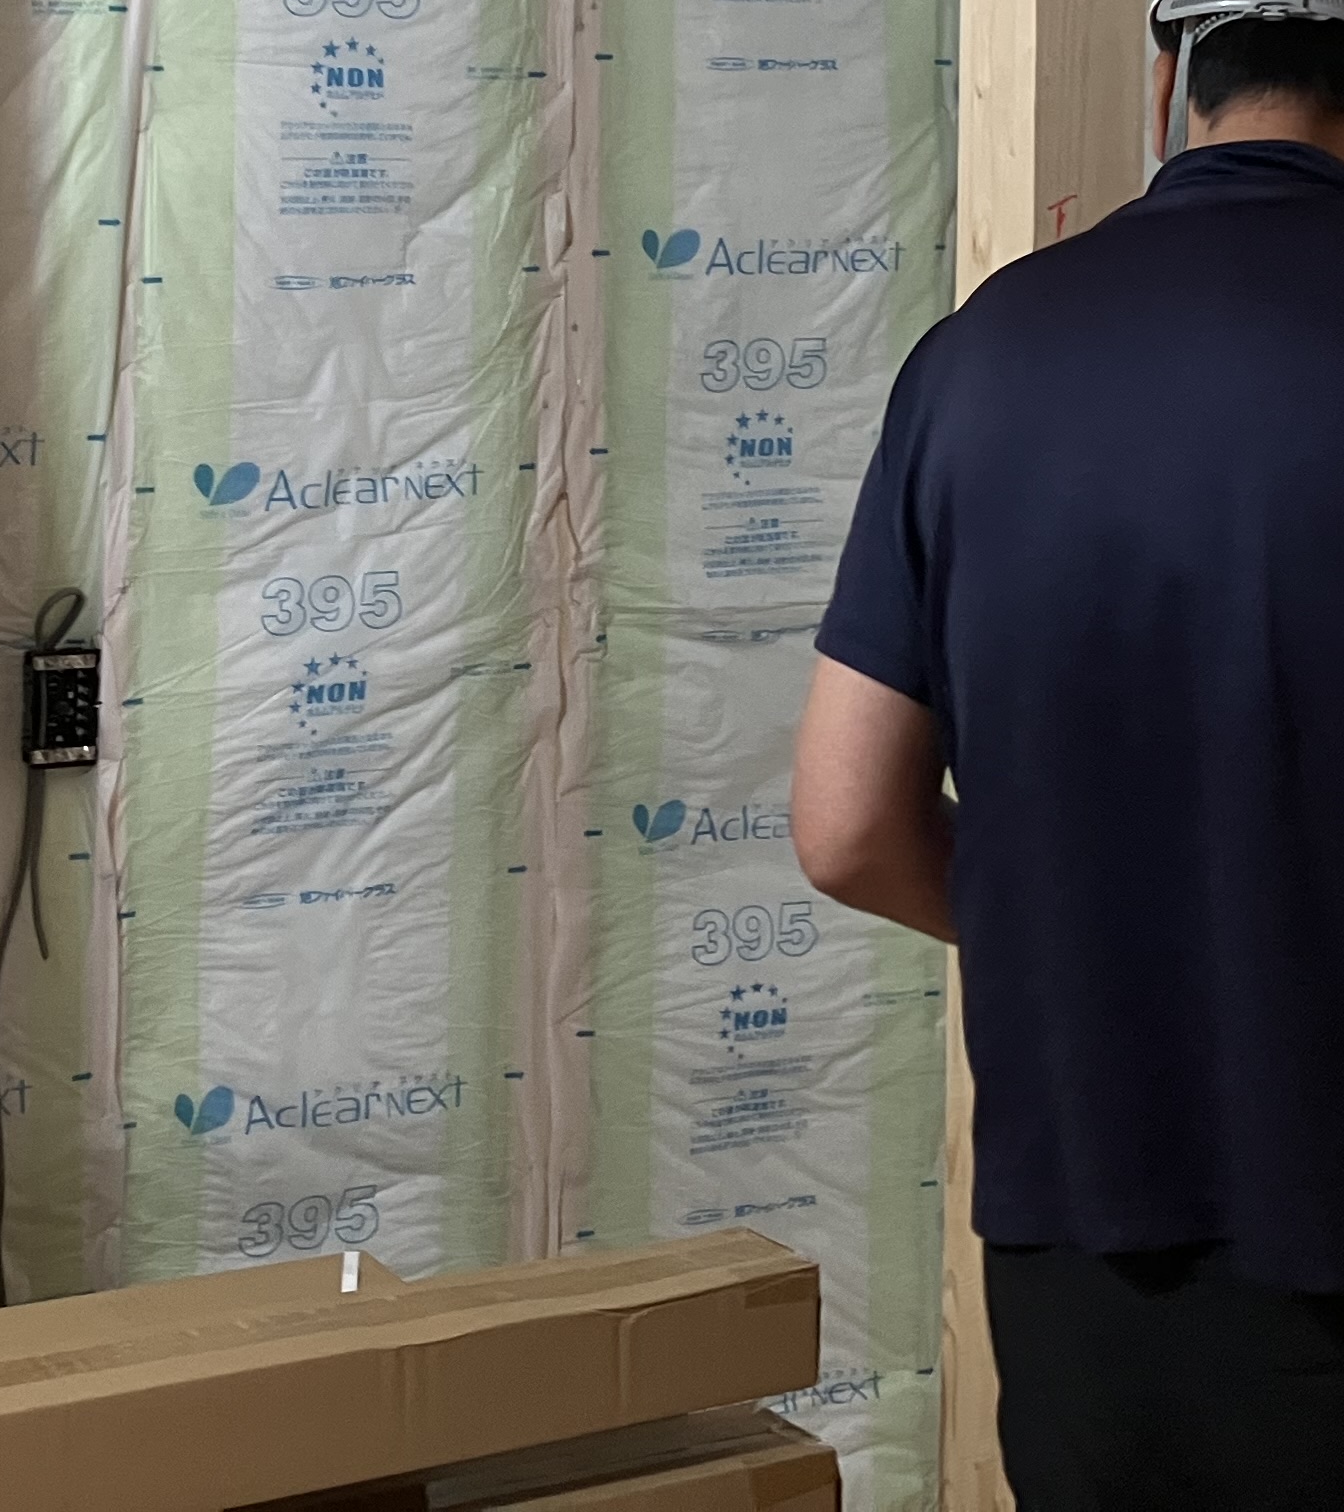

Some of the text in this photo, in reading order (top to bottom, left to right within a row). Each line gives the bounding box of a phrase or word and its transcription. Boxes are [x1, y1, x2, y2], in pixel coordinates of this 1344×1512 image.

[326, 66, 384, 88] NON
[700, 338, 828, 393] 395
[740, 436, 793, 457] NON
[261, 571, 403, 637] 395
[306, 678, 367, 705] NON
[691, 901, 820, 966] 395
[735, 1007, 787, 1031] NON
[238, 1185, 379, 1257] 395
